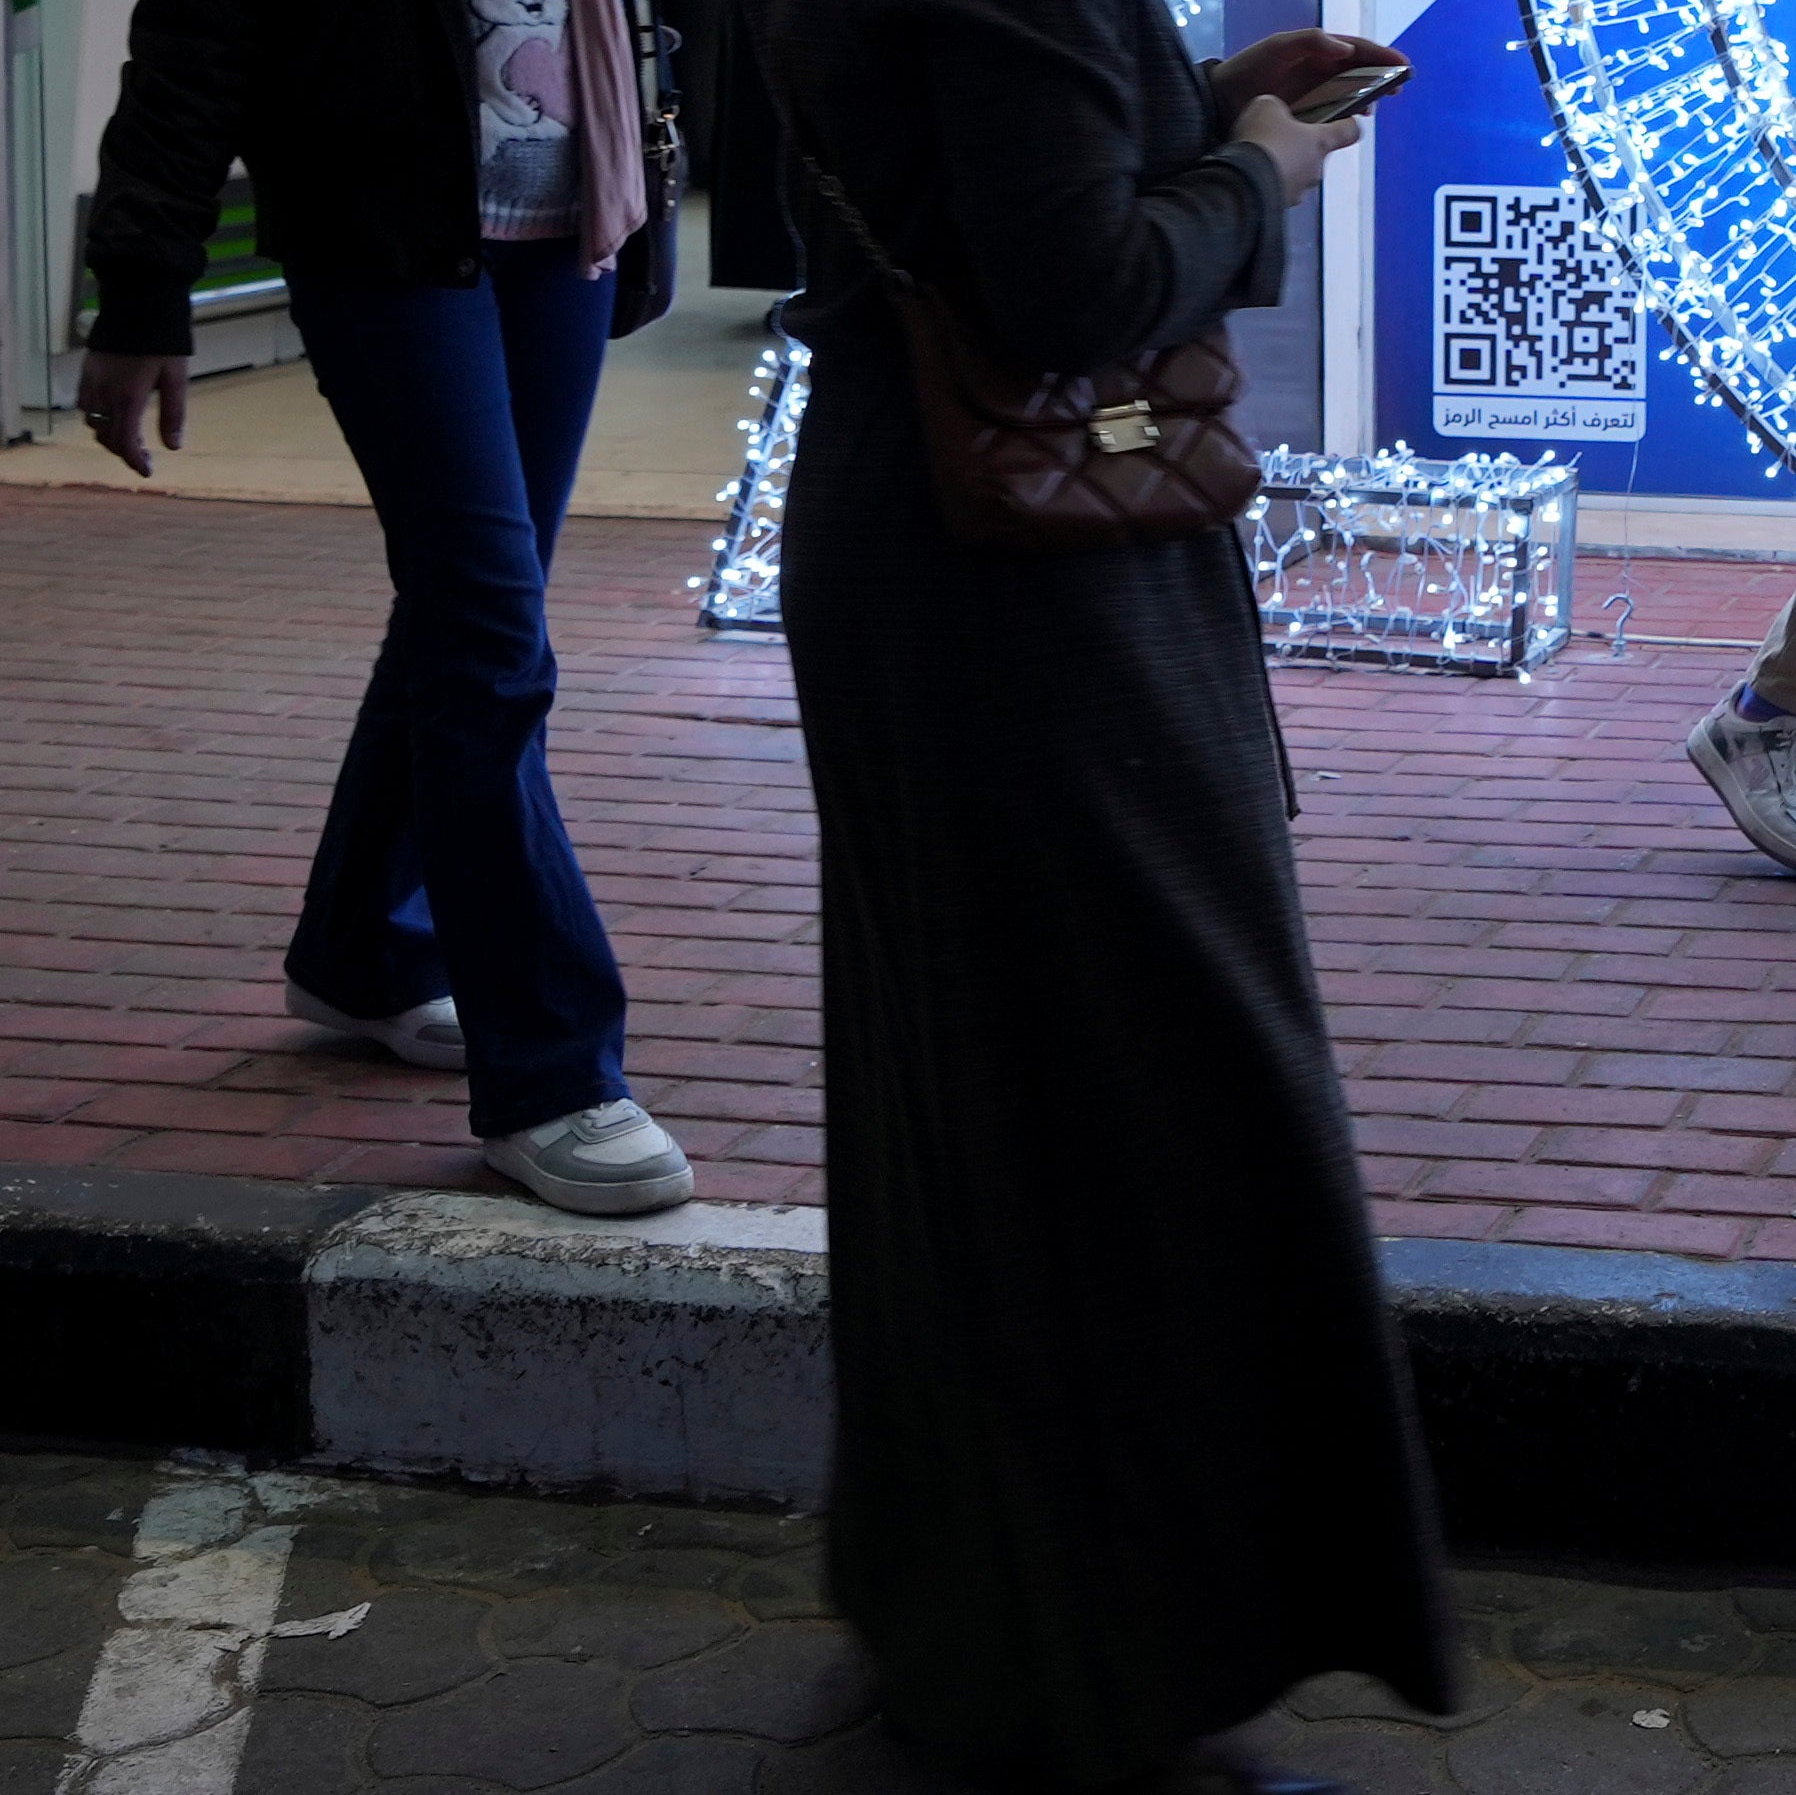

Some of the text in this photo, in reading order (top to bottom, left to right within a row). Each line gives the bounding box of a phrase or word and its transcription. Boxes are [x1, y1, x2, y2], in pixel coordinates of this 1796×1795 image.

[1442, 405, 1635, 432] لتعرف أكثر امسح الرمز
